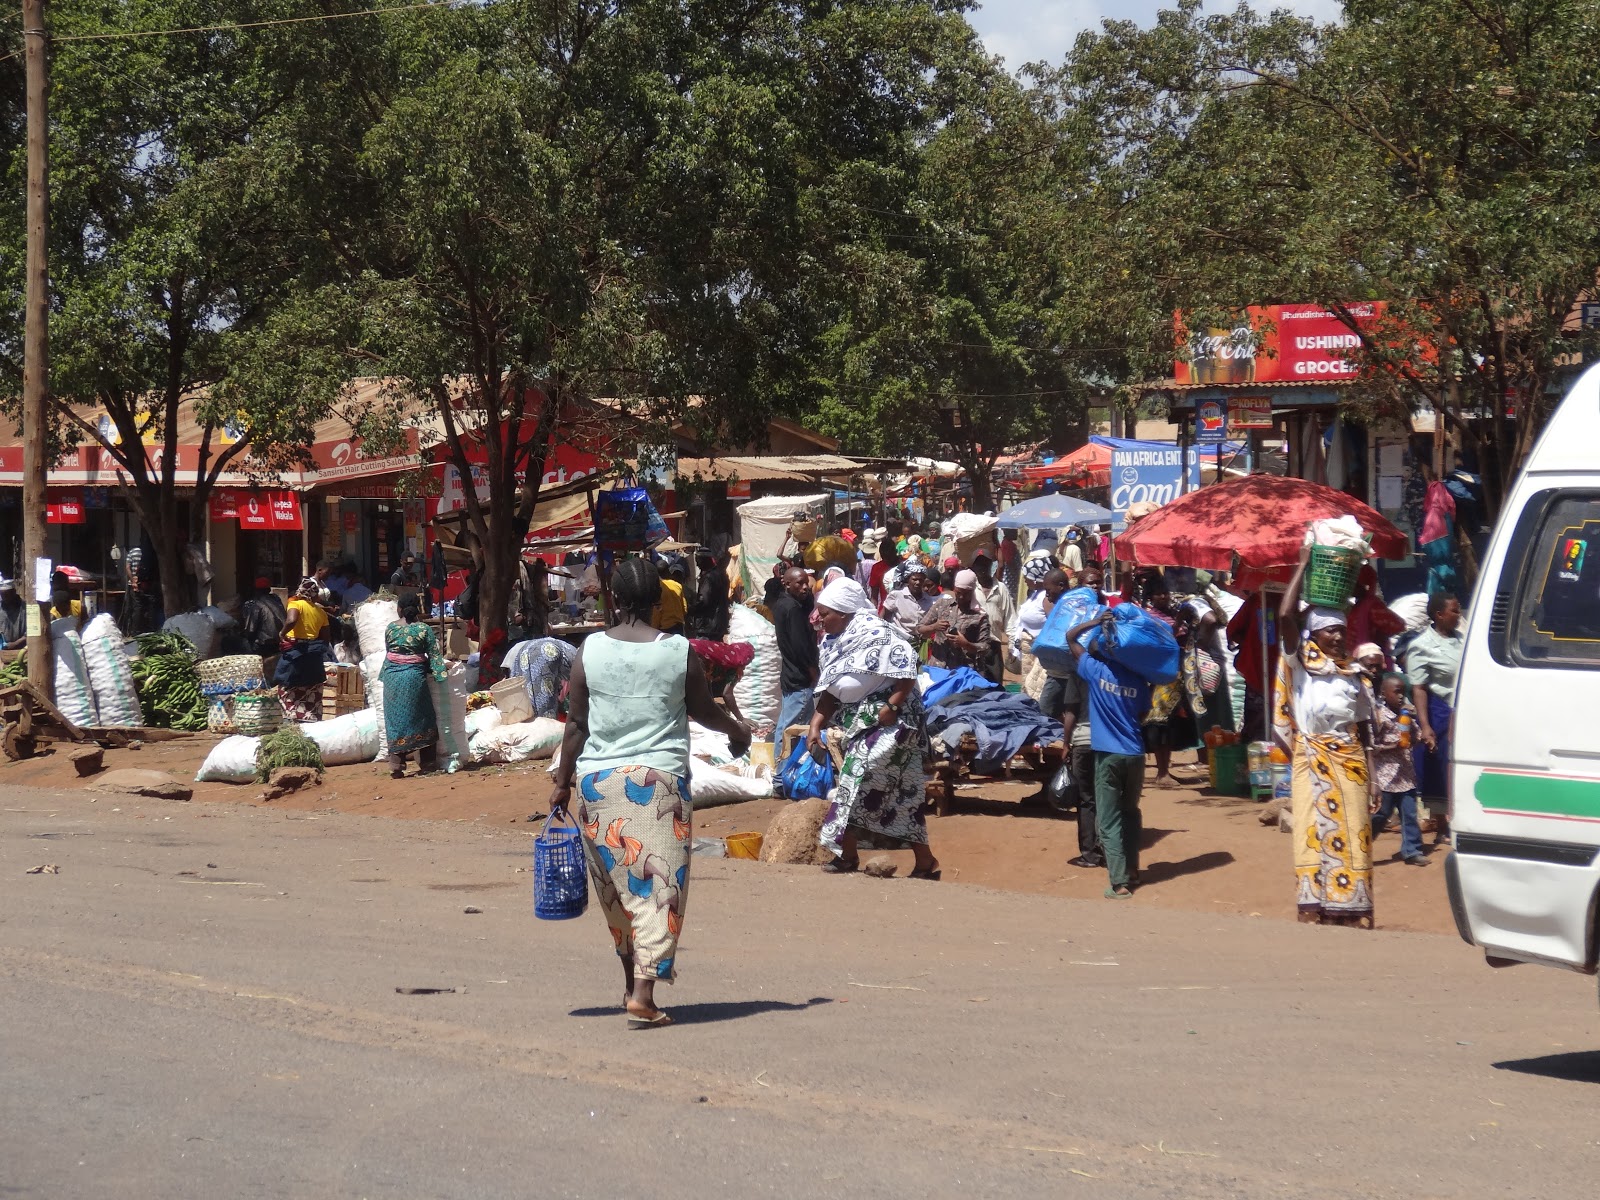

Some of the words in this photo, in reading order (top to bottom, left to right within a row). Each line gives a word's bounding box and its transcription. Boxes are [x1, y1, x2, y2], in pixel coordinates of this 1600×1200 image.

[1296, 335, 1362, 349] USHINDI
[1294, 361, 1360, 374] GROCE
[1115, 452, 1132, 466] PAN
[1133, 451, 1165, 467] AFRICA
[1187, 450, 1197, 465] TD
[319, 465, 345, 478] Sansiro
[345, 463, 360, 474] Hair
[360, 459, 386, 471] Cutting
[386, 454, 407, 467] Salon
[274, 511, 294, 520] Wakala
